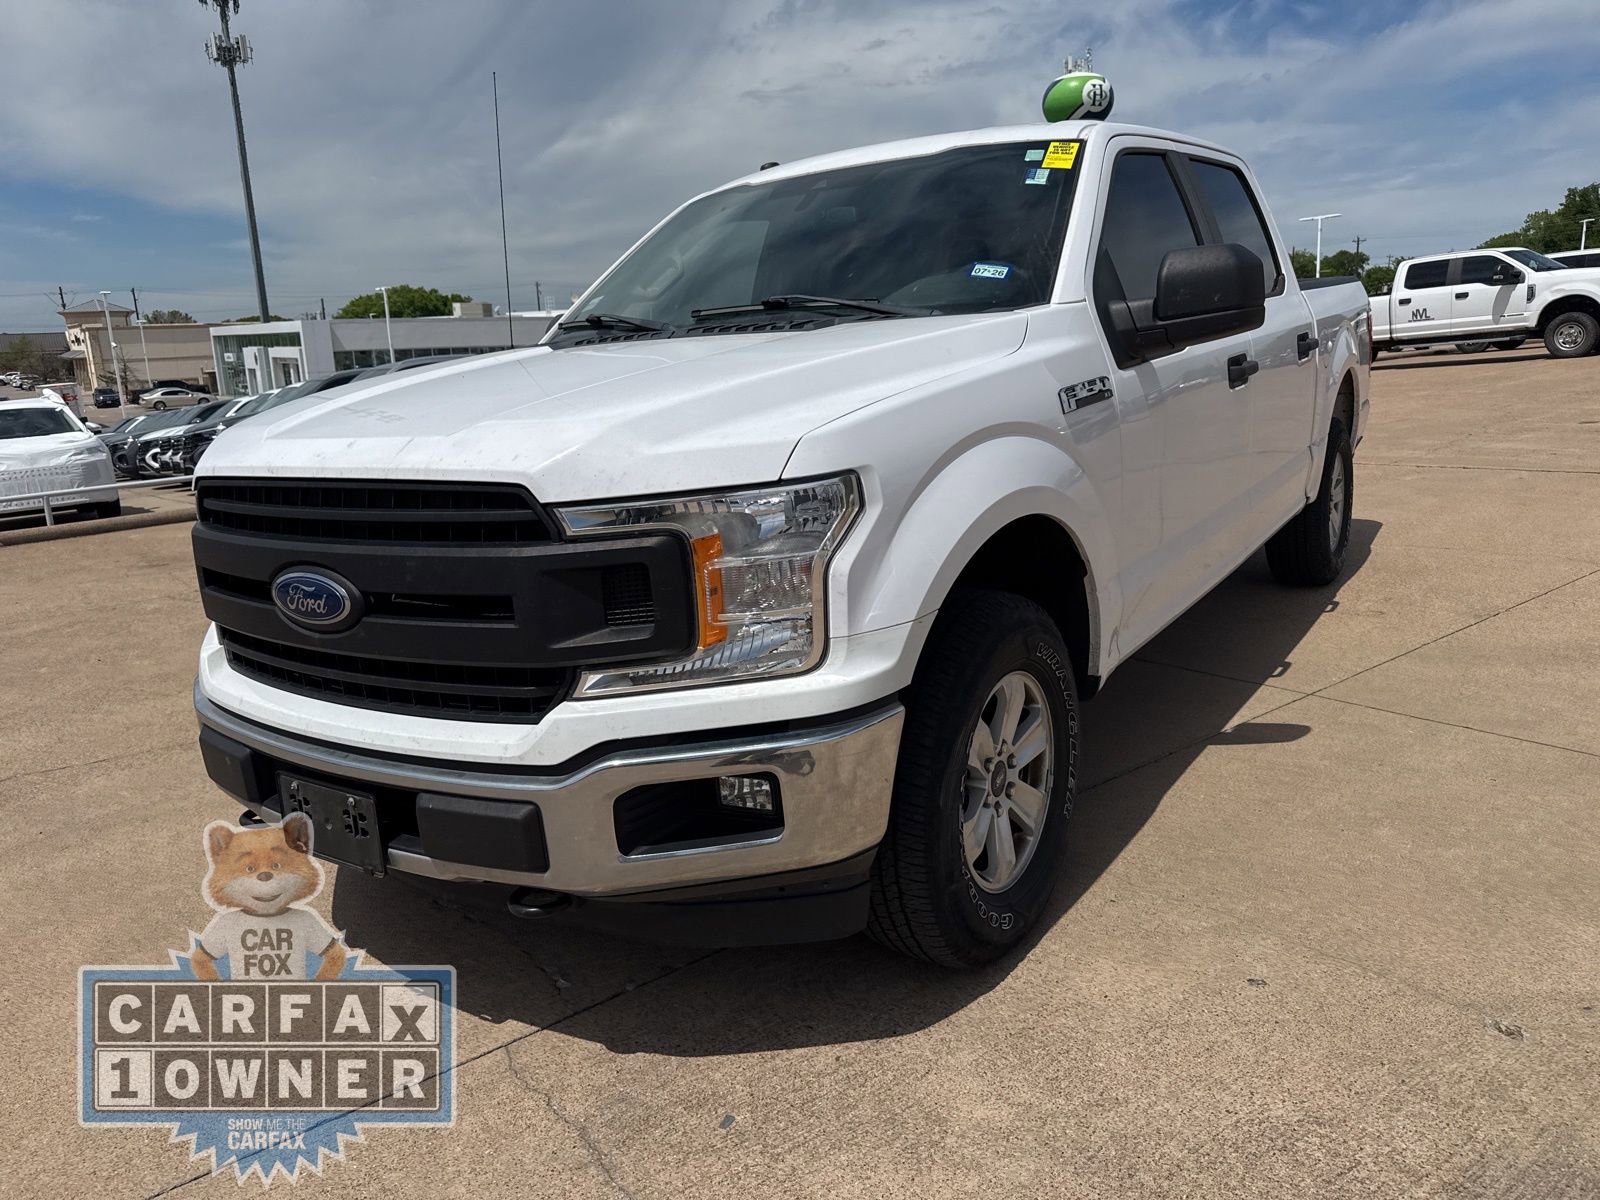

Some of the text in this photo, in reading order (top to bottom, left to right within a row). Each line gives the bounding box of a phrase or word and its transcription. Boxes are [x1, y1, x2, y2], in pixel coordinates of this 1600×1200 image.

[1411, 307, 1431, 320] NVL
[287, 583, 328, 613] Ford
[1036, 642, 1079, 819] WRANGLER
